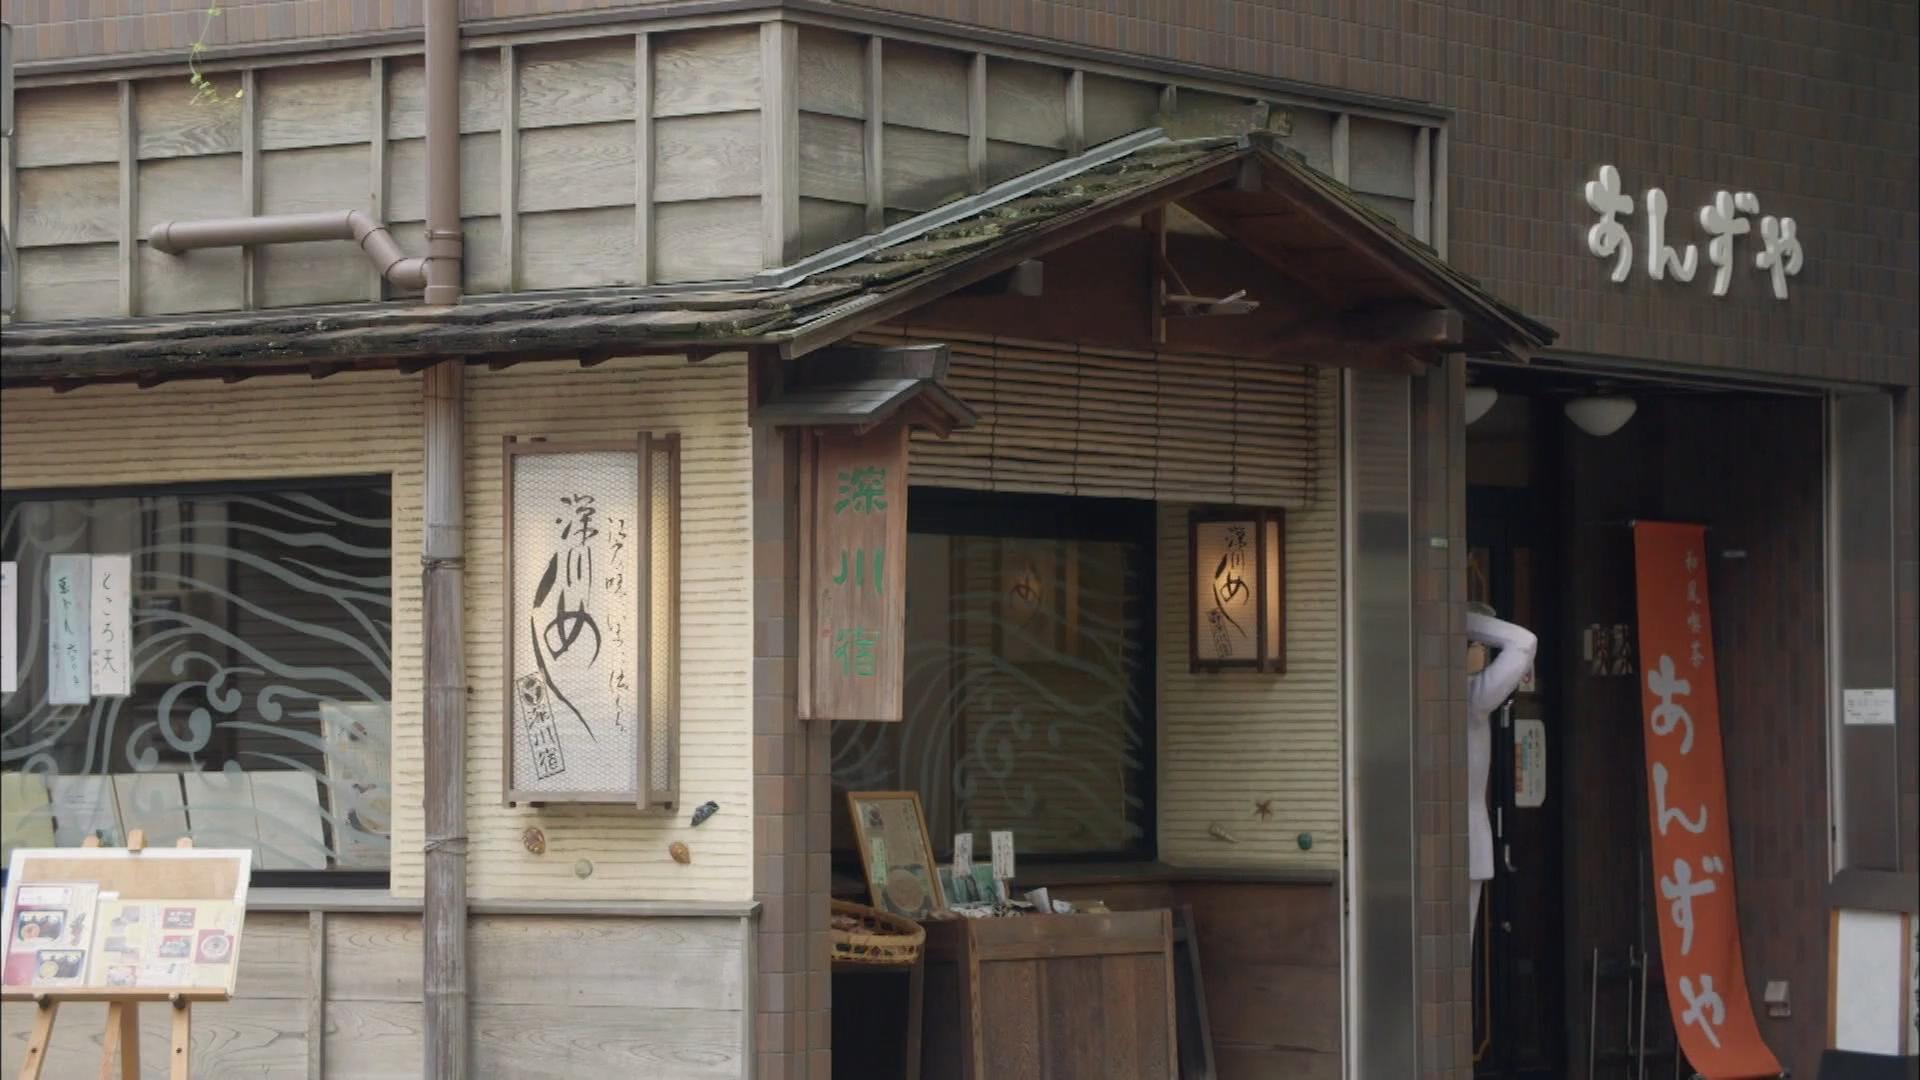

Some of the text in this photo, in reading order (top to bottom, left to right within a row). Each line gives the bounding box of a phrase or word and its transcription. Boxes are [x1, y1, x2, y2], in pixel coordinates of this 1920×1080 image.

[1585, 165, 1804, 299] あんずや
[833, 466, 887, 677] 深川宿
[1647, 653, 1725, 1050] あんずや
